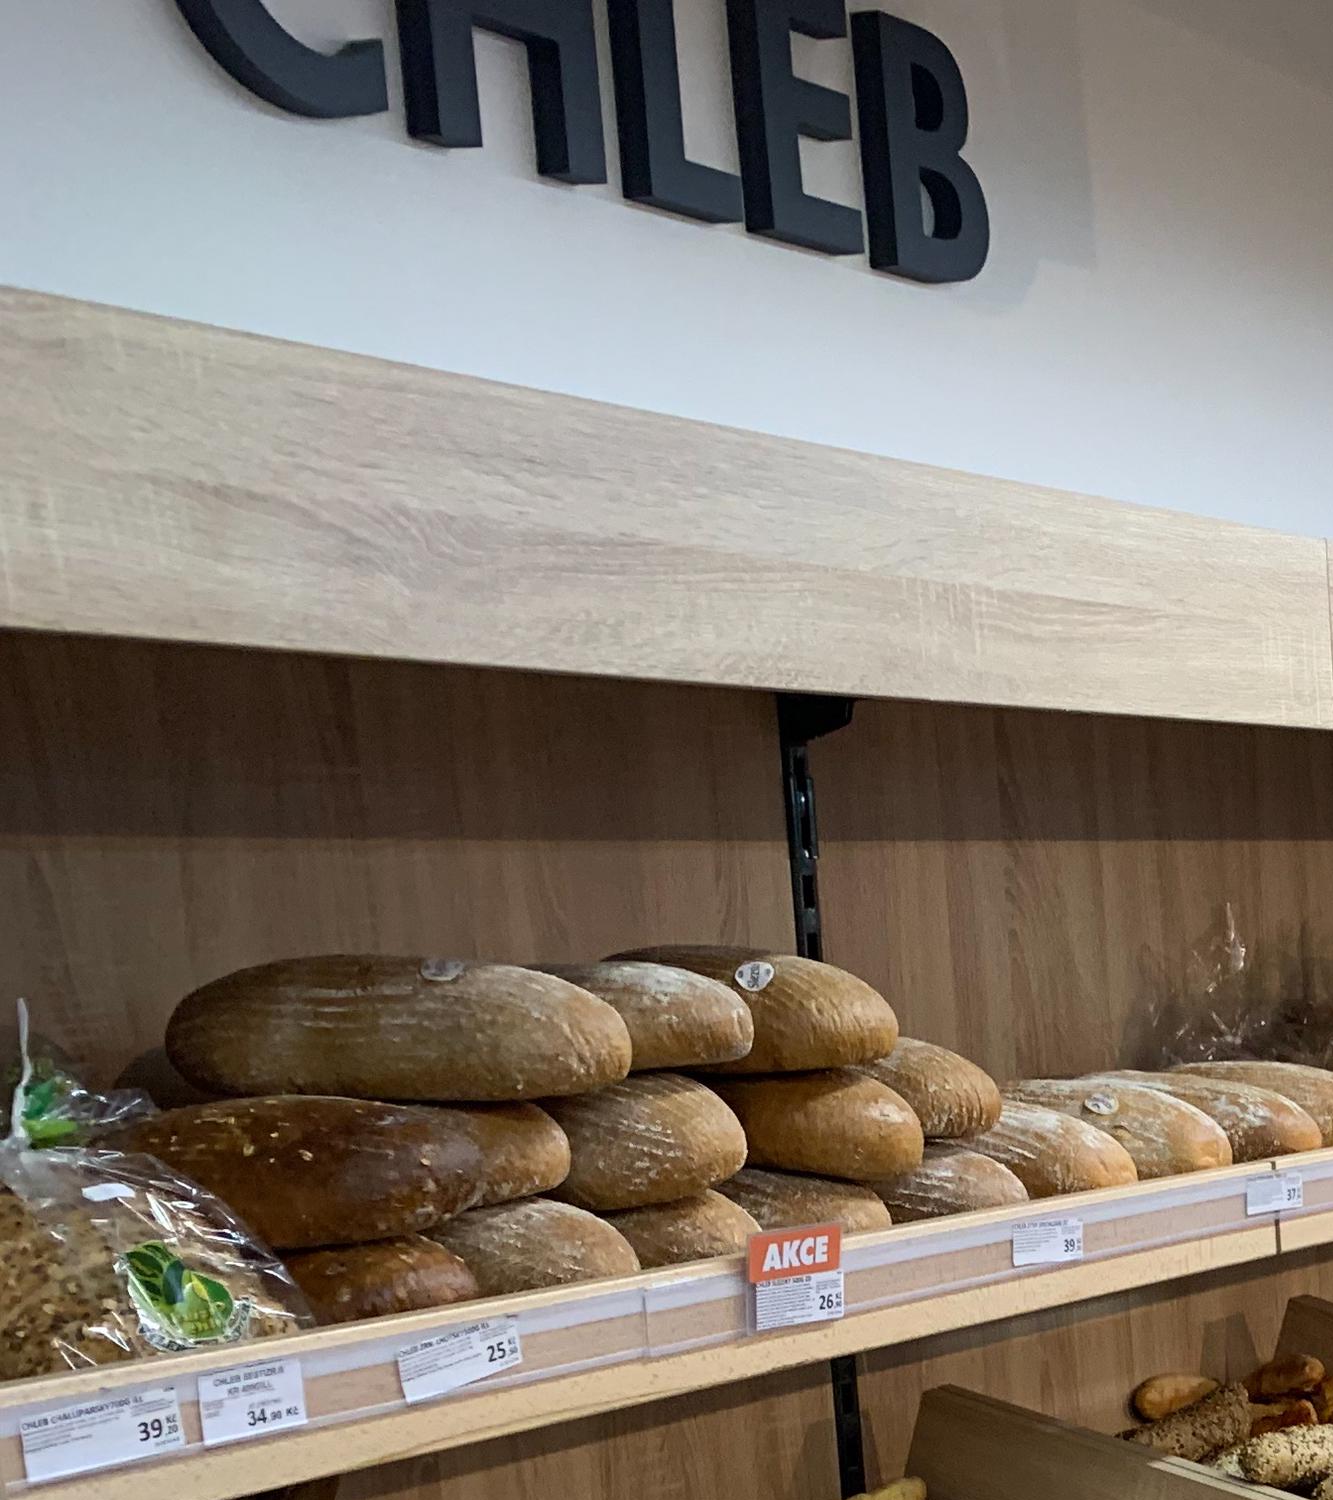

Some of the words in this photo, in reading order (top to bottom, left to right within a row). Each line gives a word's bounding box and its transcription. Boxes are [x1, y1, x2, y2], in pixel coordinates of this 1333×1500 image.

[762, 1235, 829, 1272] AKCE
[819, 1294, 834, 1310] 26
[487, 1342, 506, 1362] 25
[138, 1418, 162, 1442] 39
